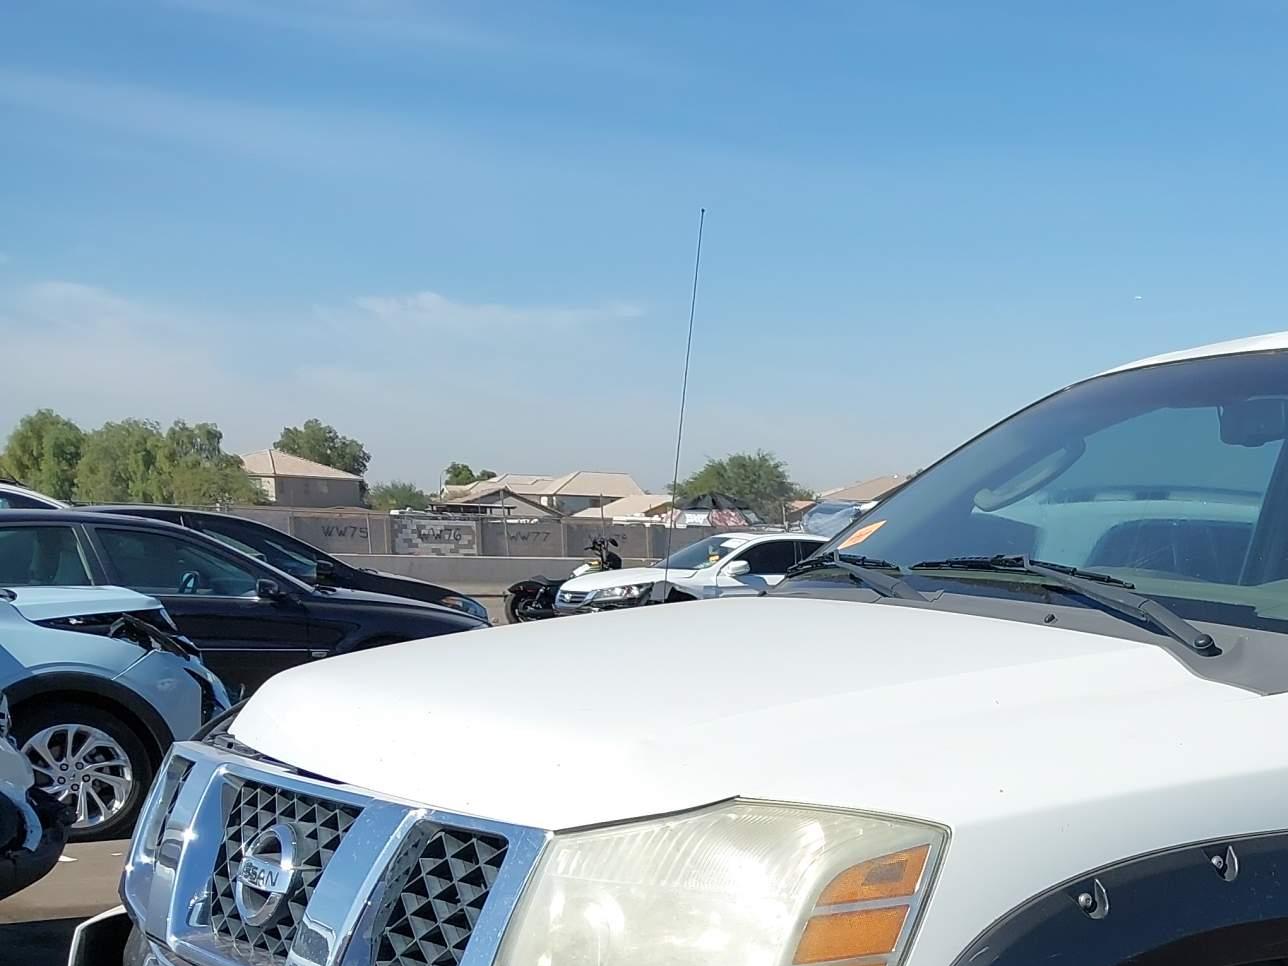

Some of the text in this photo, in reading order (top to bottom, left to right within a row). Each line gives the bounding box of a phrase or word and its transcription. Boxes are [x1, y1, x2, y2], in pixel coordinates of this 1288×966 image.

[321, 525, 369, 540] WW75
[418, 526, 463, 542] WW76
[506, 530, 553, 543] WW77
